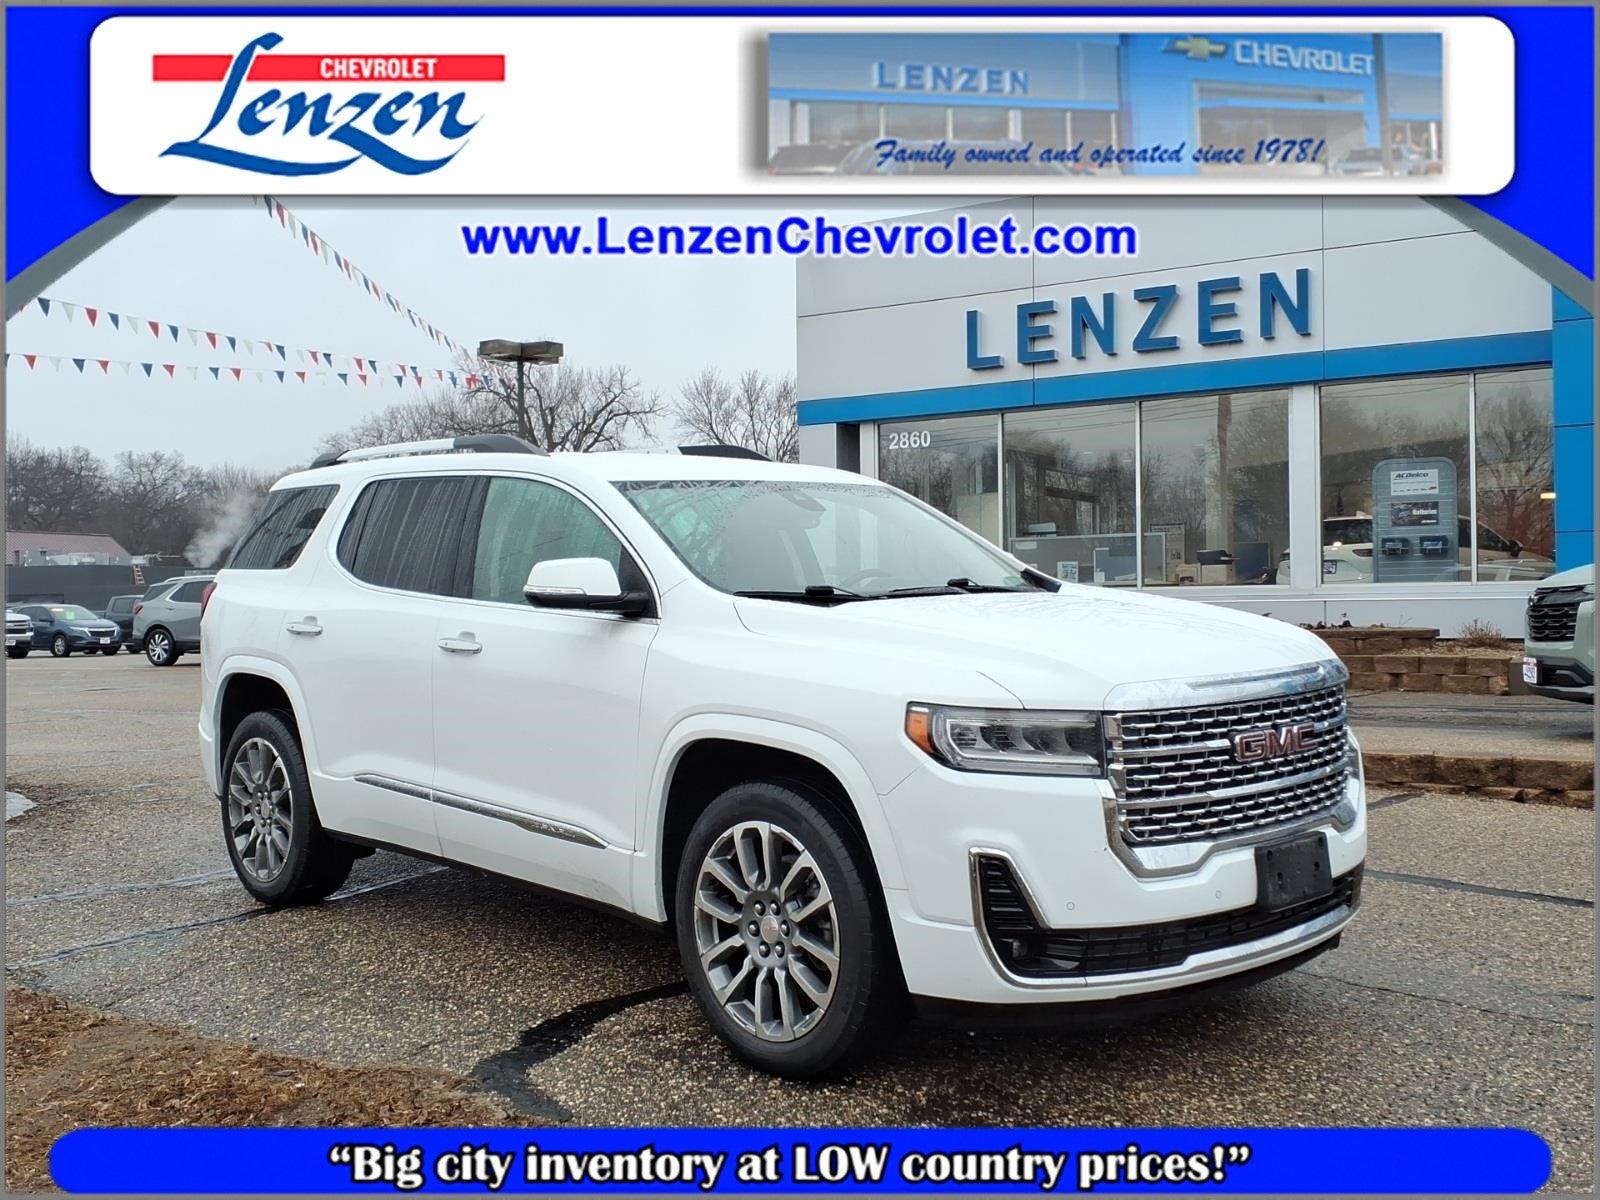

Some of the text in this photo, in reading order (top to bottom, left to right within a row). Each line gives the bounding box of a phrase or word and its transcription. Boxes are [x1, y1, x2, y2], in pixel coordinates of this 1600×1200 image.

[966, 268, 1312, 371] LENZEN
[888, 430, 931, 450] 2860
[1234, 721, 1319, 762] GMC
